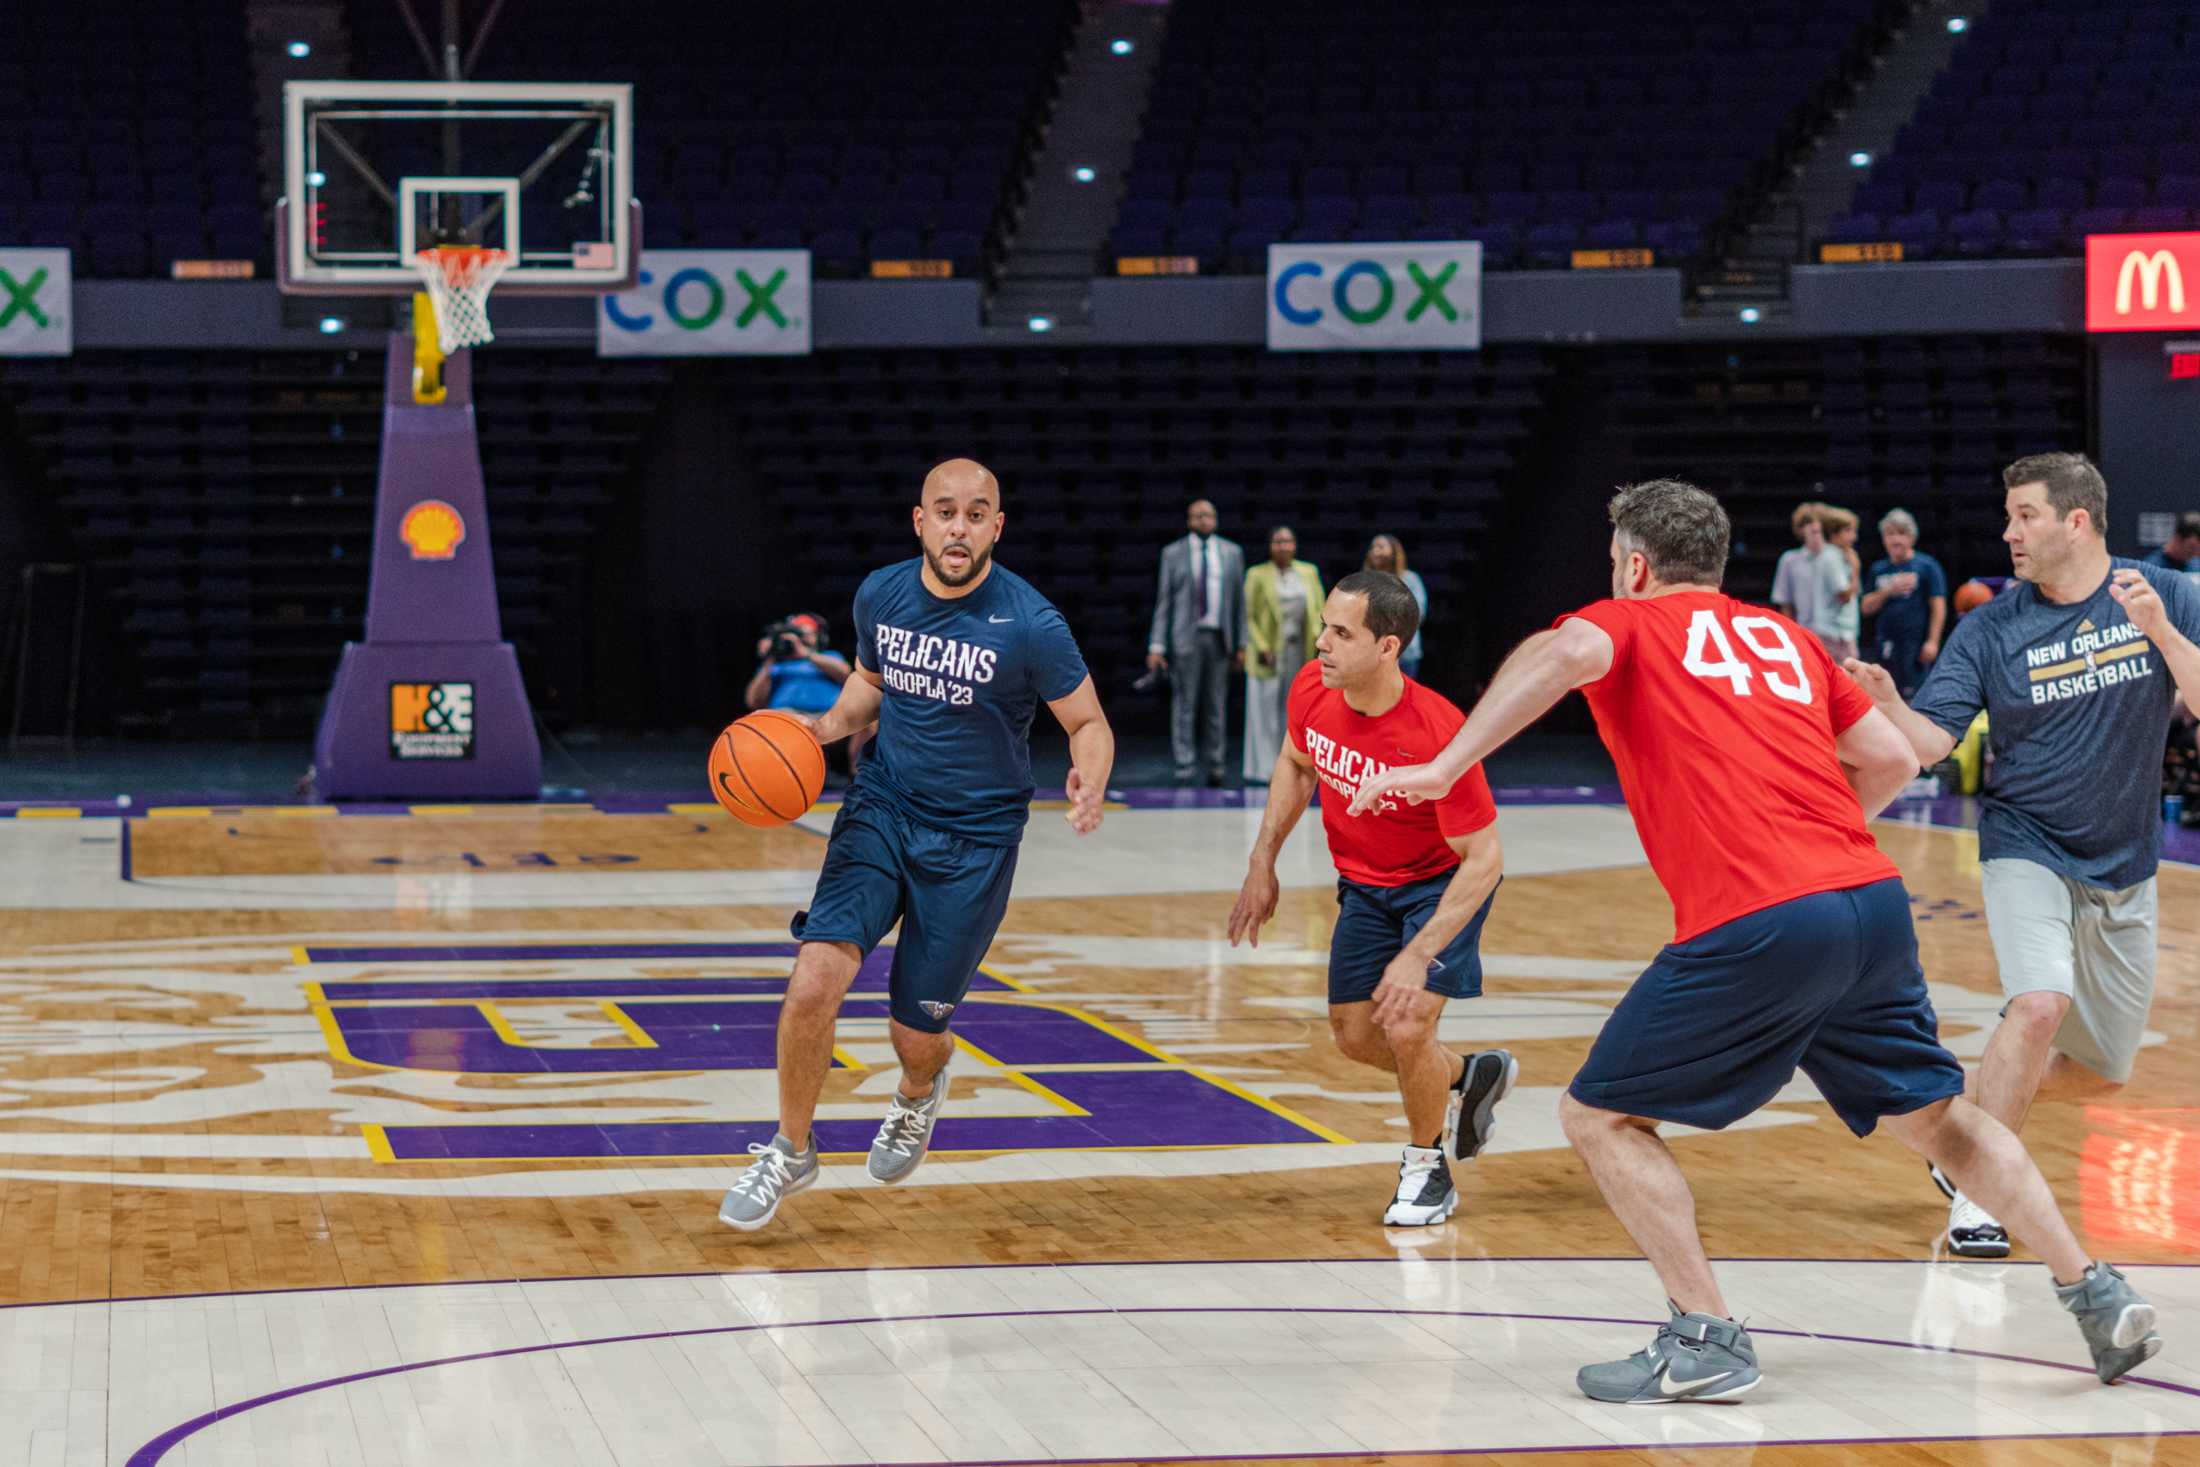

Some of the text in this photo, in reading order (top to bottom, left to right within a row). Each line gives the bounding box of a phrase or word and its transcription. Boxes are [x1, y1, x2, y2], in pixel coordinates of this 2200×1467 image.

[1275, 260, 1459, 325] COX
[876, 623, 998, 683] PELICANS
[1682, 610, 1813, 705] 49
[2026, 641, 2066, 667] NEW
[2030, 656, 2153, 704] BASKETBALL
[391, 682, 473, 732] H&E
